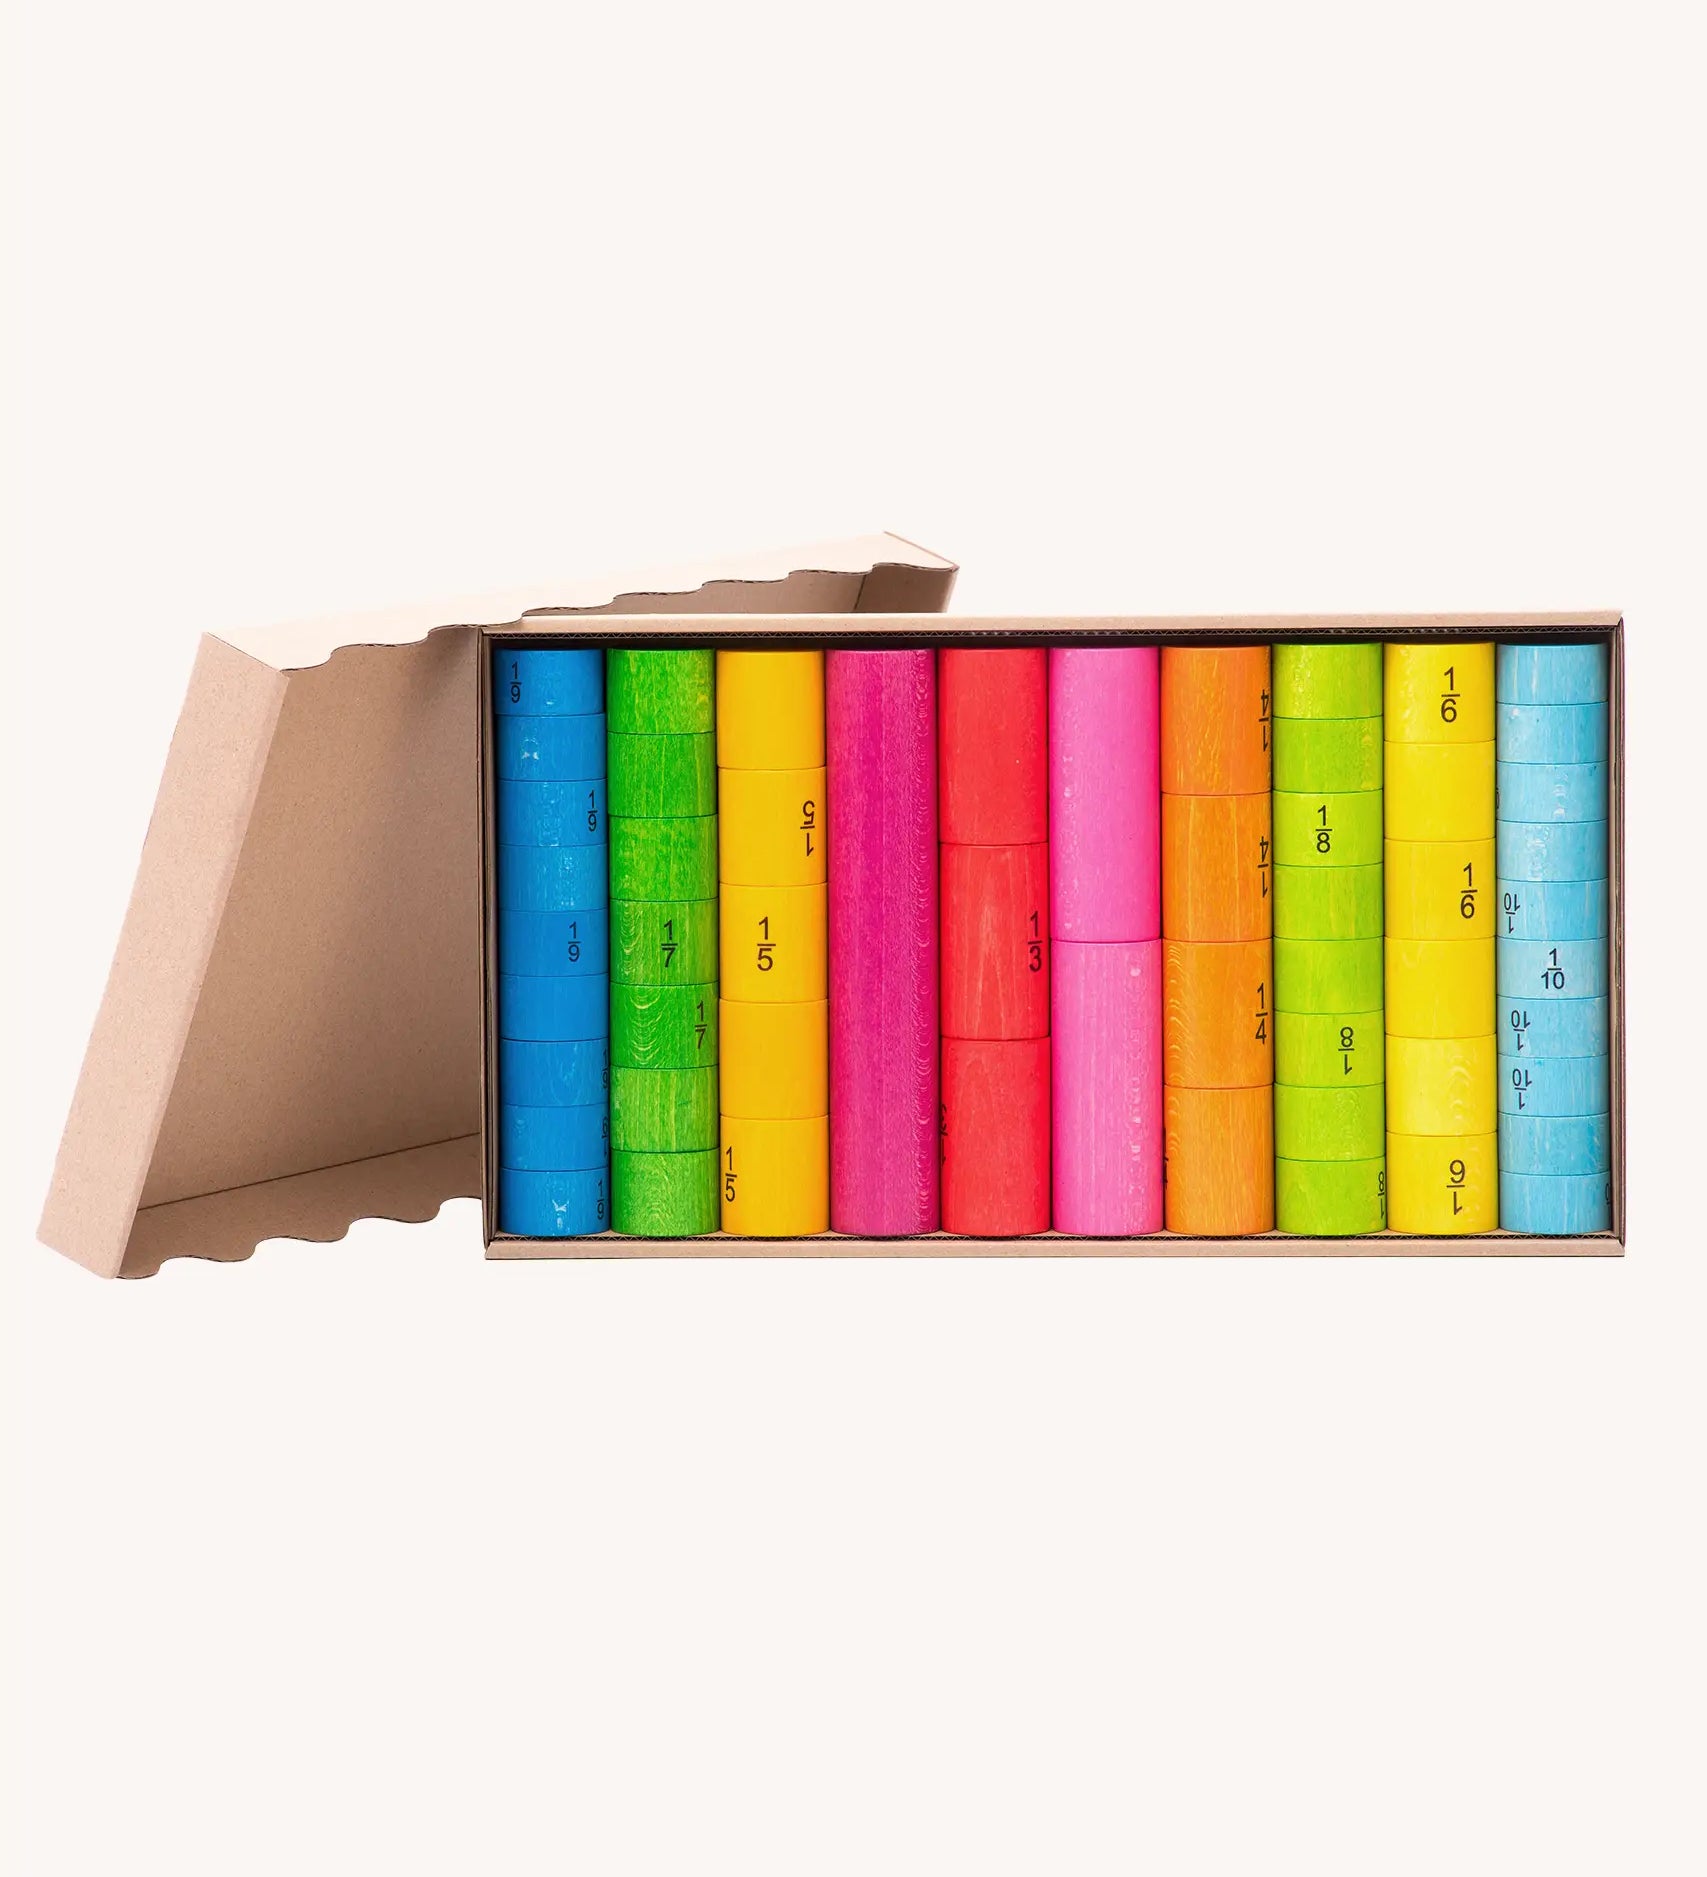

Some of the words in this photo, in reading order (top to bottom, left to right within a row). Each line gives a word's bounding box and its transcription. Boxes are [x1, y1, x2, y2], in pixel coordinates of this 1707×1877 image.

[511, 661, 518, 680] 1
[1444, 666, 1454, 691] 1
[510, 685, 521, 704] 9
[1440, 699, 1457, 723] 6
[588, 789, 596, 809] 1
[588, 813, 597, 832] 9
[802, 801, 815, 825] 5
[1317, 804, 1327, 827] 1
[806, 832, 814, 857] 1
[1316, 832, 1331, 854] 8
[1463, 862, 1472, 887] 1
[1460, 895, 1475, 919] 6
[1503, 893, 1521, 911] 10
[569, 921, 577, 939] 1
[663, 919, 673, 941] 1
[758, 916, 769, 941] 1
[1030, 910, 1039, 937] 1
[1508, 915, 1514, 934] 1
[567, 943, 580, 962] 9
[661, 947, 676, 968] 7
[757, 948, 774, 972] 5
[1029, 945, 1043, 973] 3
[1549, 947, 1557, 967] 1
[1541, 972, 1565, 990] 10
[1257, 982, 1265, 1010] 1
[696, 1000, 704, 1022] 1
[1510, 1010, 1531, 1029] 10
[695, 1028, 706, 1050] 7
[1255, 1019, 1267, 1045] 4
[1340, 1027, 1354, 1048] 8
[1517, 1033, 1524, 1051] 1
[1344, 1054, 1353, 1075] 1
[1512, 1069, 1532, 1088] 10
[1518, 1091, 1526, 1110] 1
[726, 1146, 733, 1171] 1
[1449, 1160, 1466, 1184] 6
[725, 1178, 736, 1203] 5
[1453, 1191, 1463, 1216] 1
